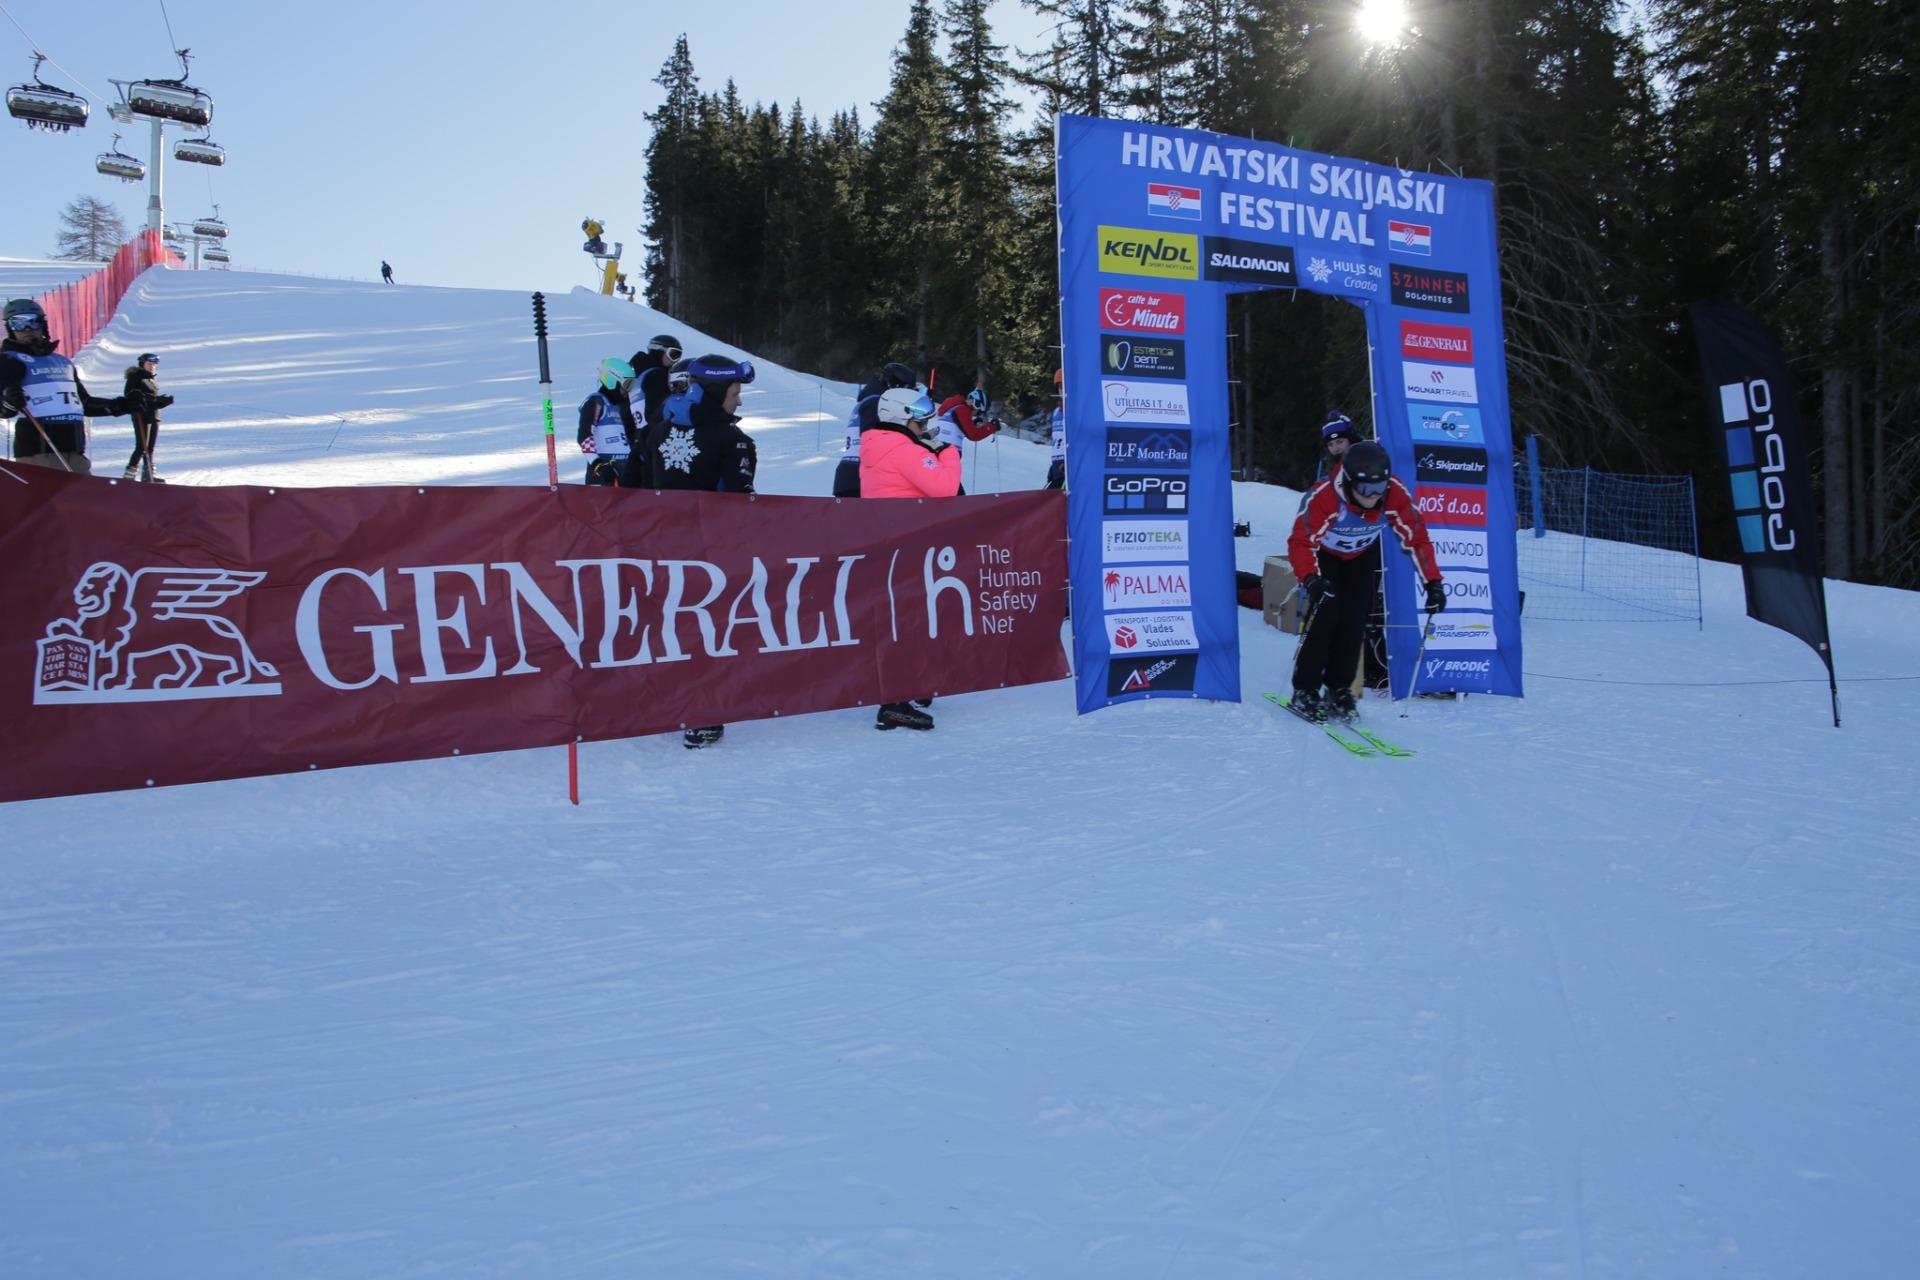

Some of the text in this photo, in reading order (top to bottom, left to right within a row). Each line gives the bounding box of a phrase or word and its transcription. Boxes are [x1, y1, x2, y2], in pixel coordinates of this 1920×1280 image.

[1122, 131, 1446, 215] HRVATSKI SKIJAŠKI
[1220, 191, 1375, 247] FESTIVAL
[1104, 238, 1192, 267] KEINDL
[1210, 253, 1290, 273] SALOMON
[1333, 260, 1382, 279] HULJS SKI
[1344, 276, 1378, 292] Croatia
[1147, 296, 1160, 305] bar
[1405, 291, 1453, 304] DOLOMITES
[1132, 308, 1179, 329] Minuta
[1418, 336, 1468, 352] GENERALI
[1115, 398, 1150, 408] UTILITAS
[1422, 421, 1456, 431] CARGO
[1108, 443, 1188, 460] ELF Mont-Bau
[1435, 460, 1485, 472] Skiportal.hr
[1107, 478, 1186, 493] GoPro
[1419, 494, 1484, 515] ROŠ d.o.o.
[1114, 532, 1182, 543] FIZIOTEKA
[976, 544, 1011, 564] The
[980, 567, 1042, 588] Human
[1123, 575, 1187, 595] PALMA
[980, 591, 1037, 613] Safety
[295, 554, 866, 690] GENERALI
[982, 614, 1015, 634] Net
[1142, 624, 1174, 634] Vlades
[46, 644, 64, 655] PAX
[1146, 638, 1191, 648] Solutions
[44, 661, 65, 672] MAR
[68, 661, 84, 671] STA
[1444, 660, 1491, 672] BRODIĆ
[1441, 671, 1488, 679] PROMET
